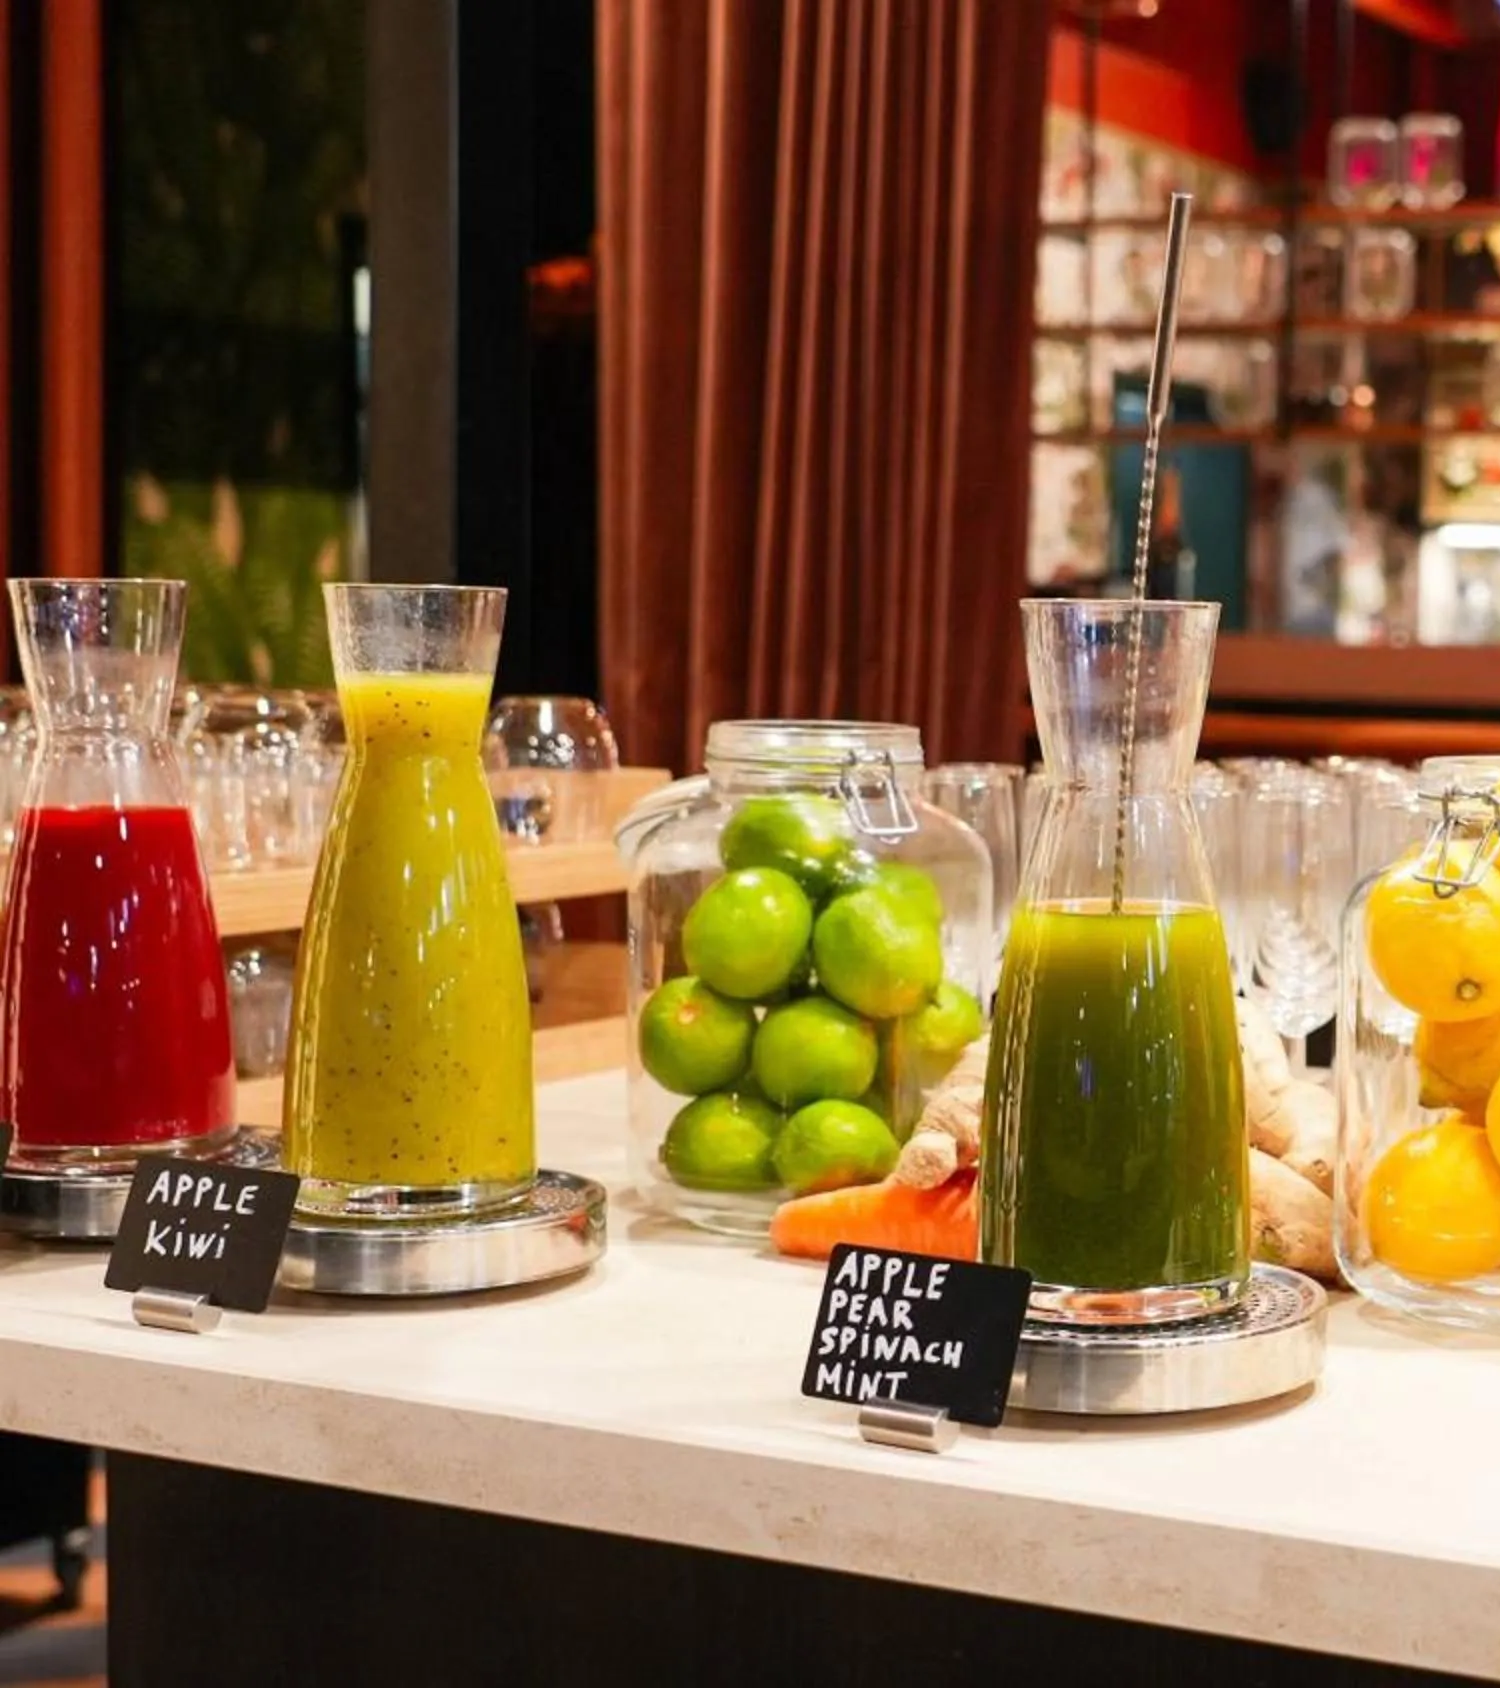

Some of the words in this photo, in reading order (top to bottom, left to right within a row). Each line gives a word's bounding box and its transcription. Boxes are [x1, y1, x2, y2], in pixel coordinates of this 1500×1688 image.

[146, 1170, 260, 1215] APPLE
[834, 1251, 951, 1300] APPLE
[827, 1289, 914, 1331] PEAR
